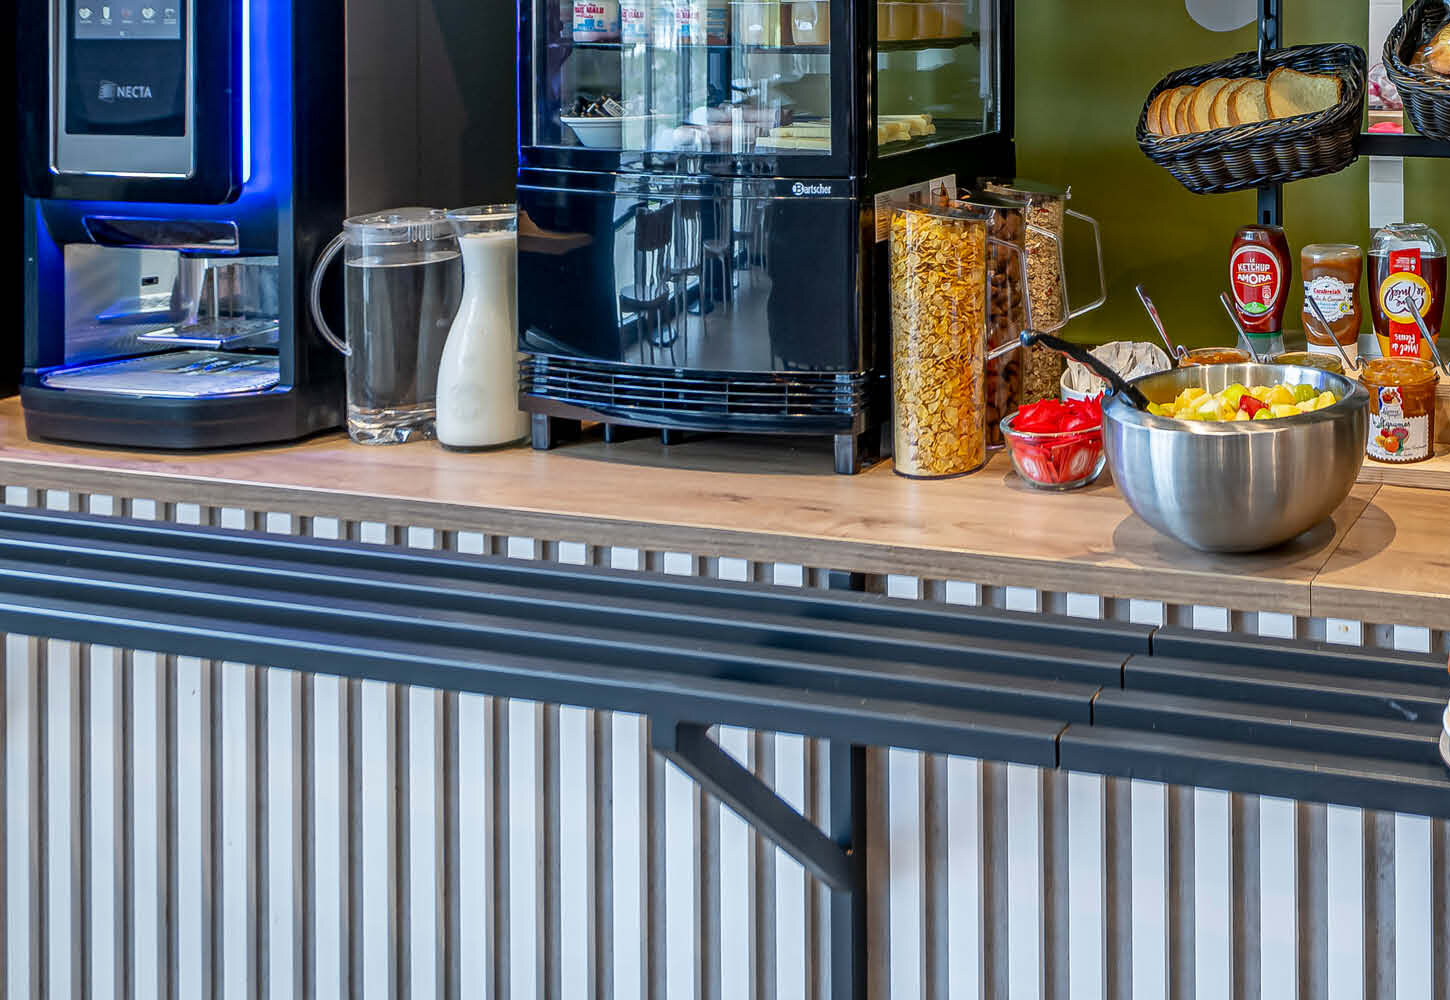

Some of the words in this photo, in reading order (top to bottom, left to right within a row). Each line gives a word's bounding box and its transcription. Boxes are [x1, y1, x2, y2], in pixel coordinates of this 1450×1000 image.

[117, 85, 152, 98] NECTA
[792, 182, 832, 196] Bartscher
[1237, 263, 1271, 272] KETCHUP
[1237, 273, 1272, 285] AMORA
